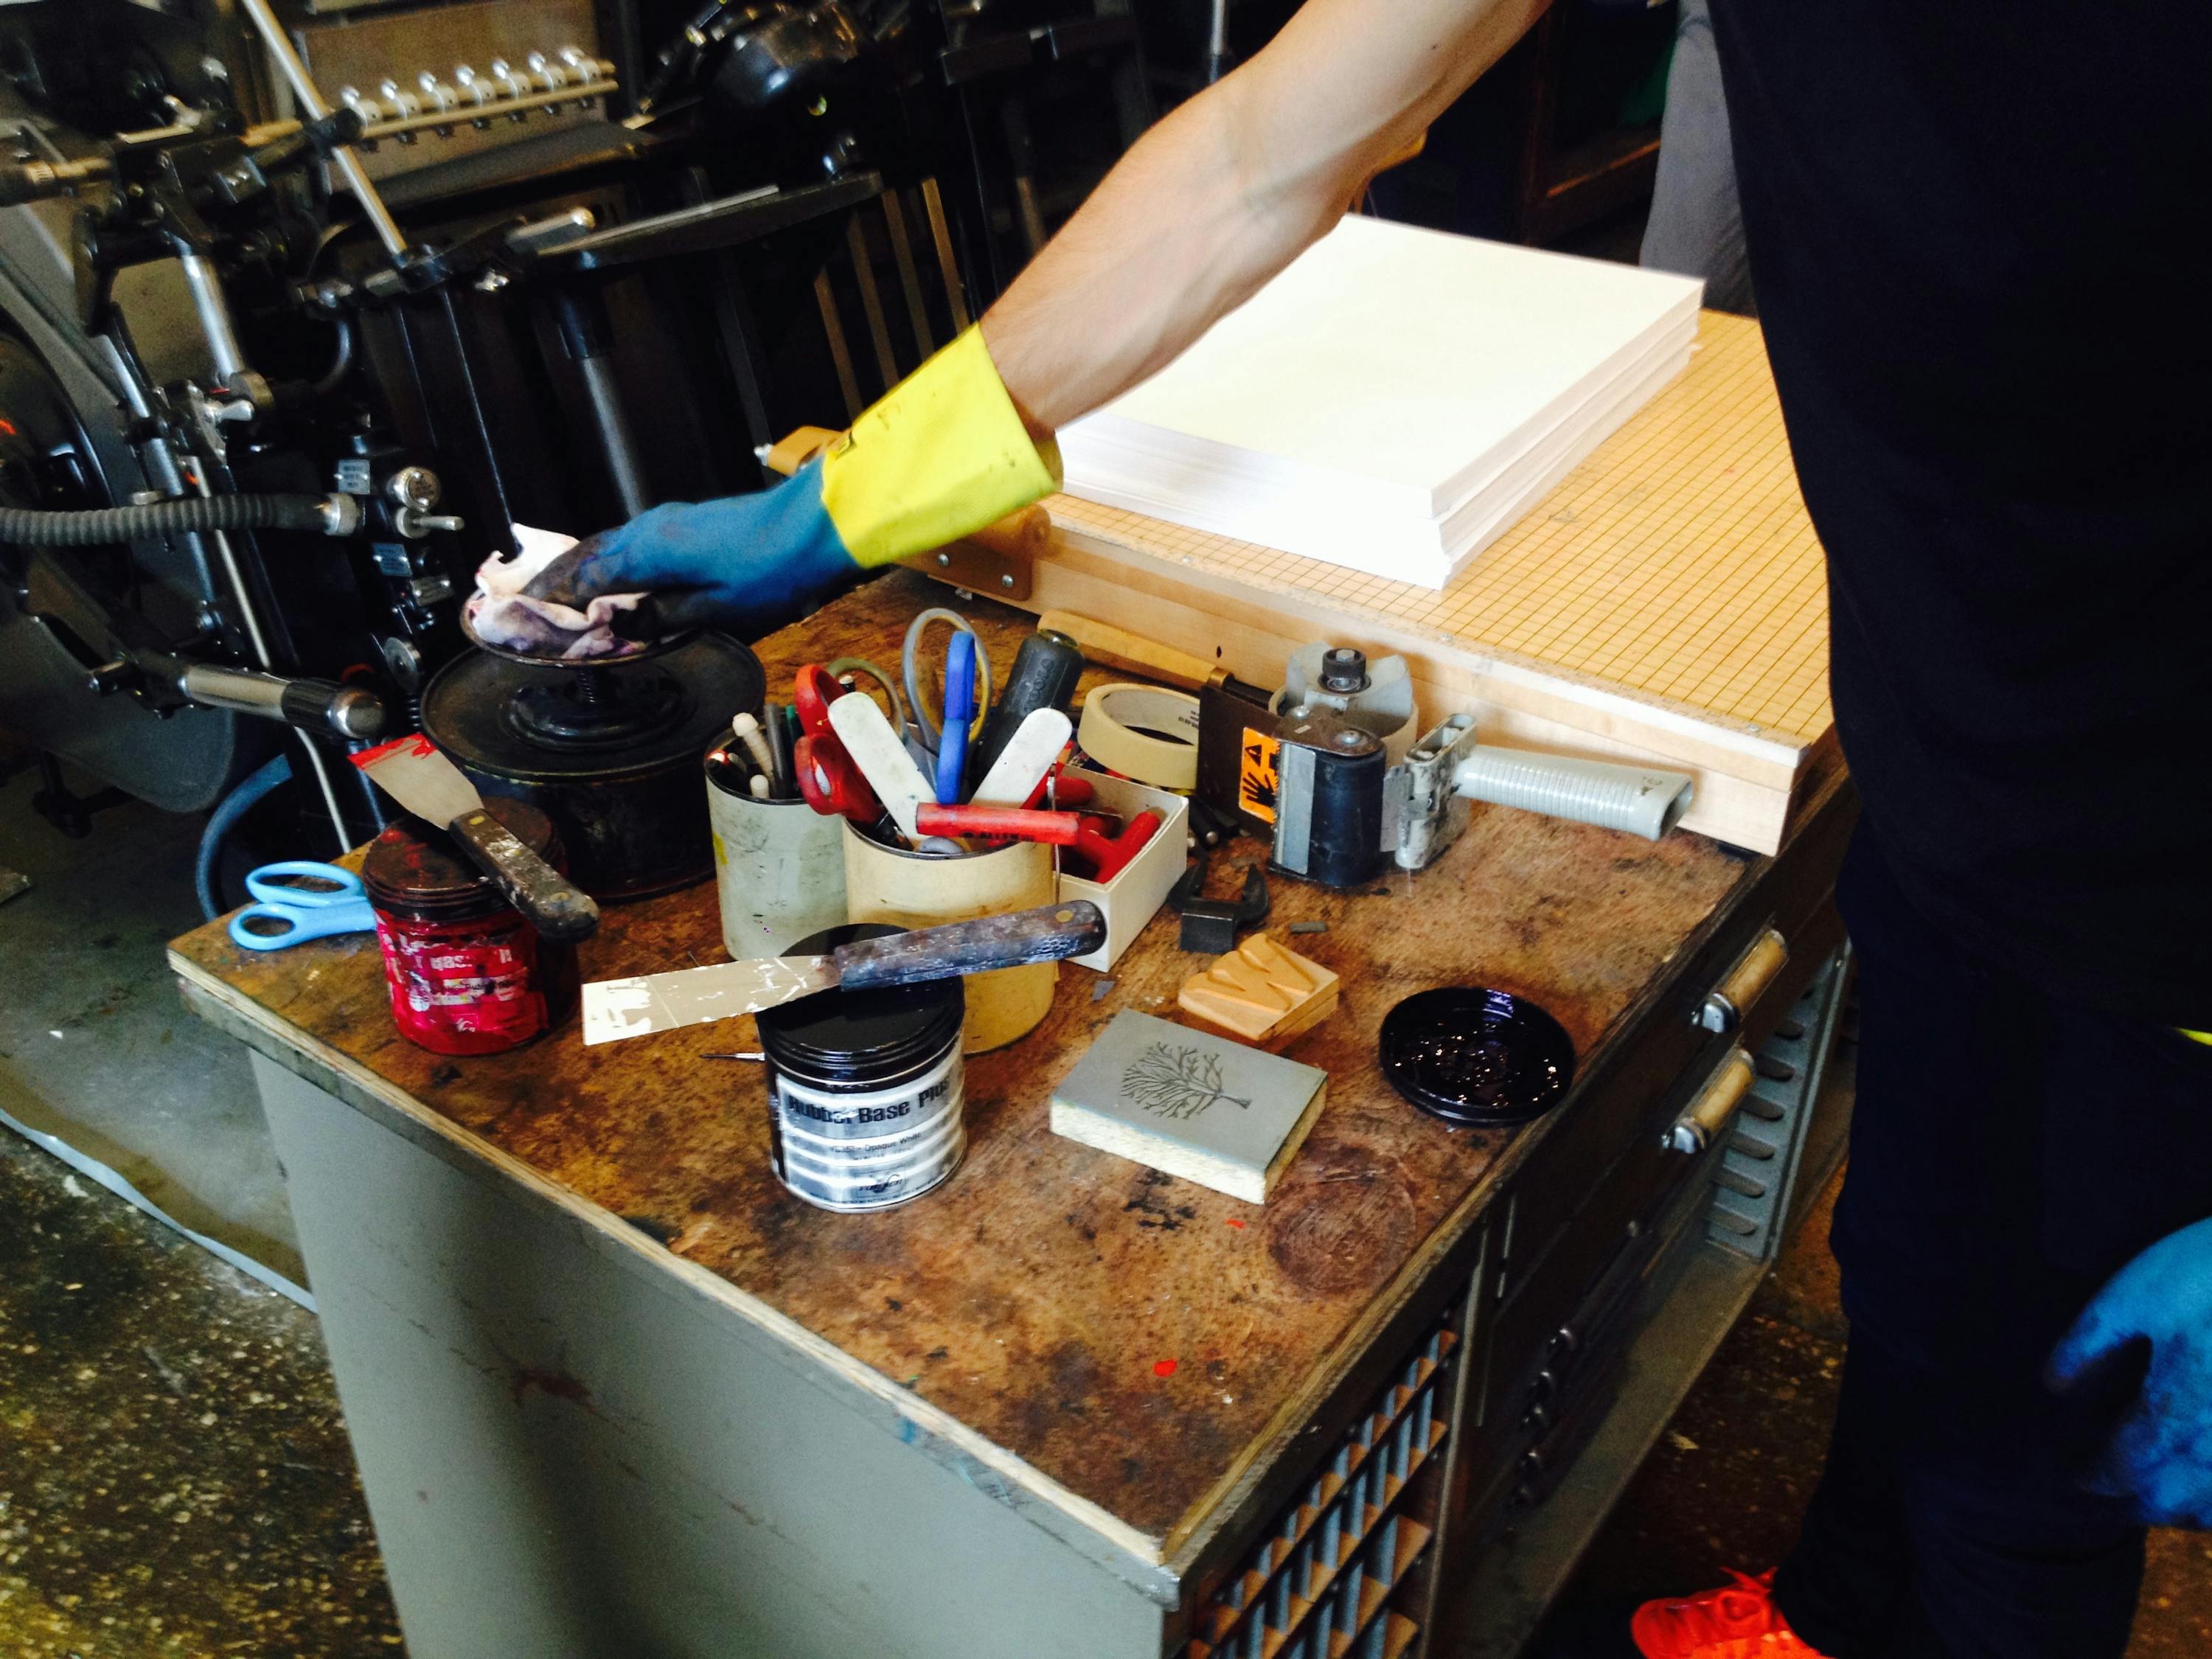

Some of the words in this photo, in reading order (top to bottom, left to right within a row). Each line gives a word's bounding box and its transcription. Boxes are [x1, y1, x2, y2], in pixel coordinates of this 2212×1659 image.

[858, 1100, 911, 1123] Base
[918, 1074, 952, 1110] Plus
[864, 1141, 897, 1152] Opaque
[899, 1133, 922, 1145] White
